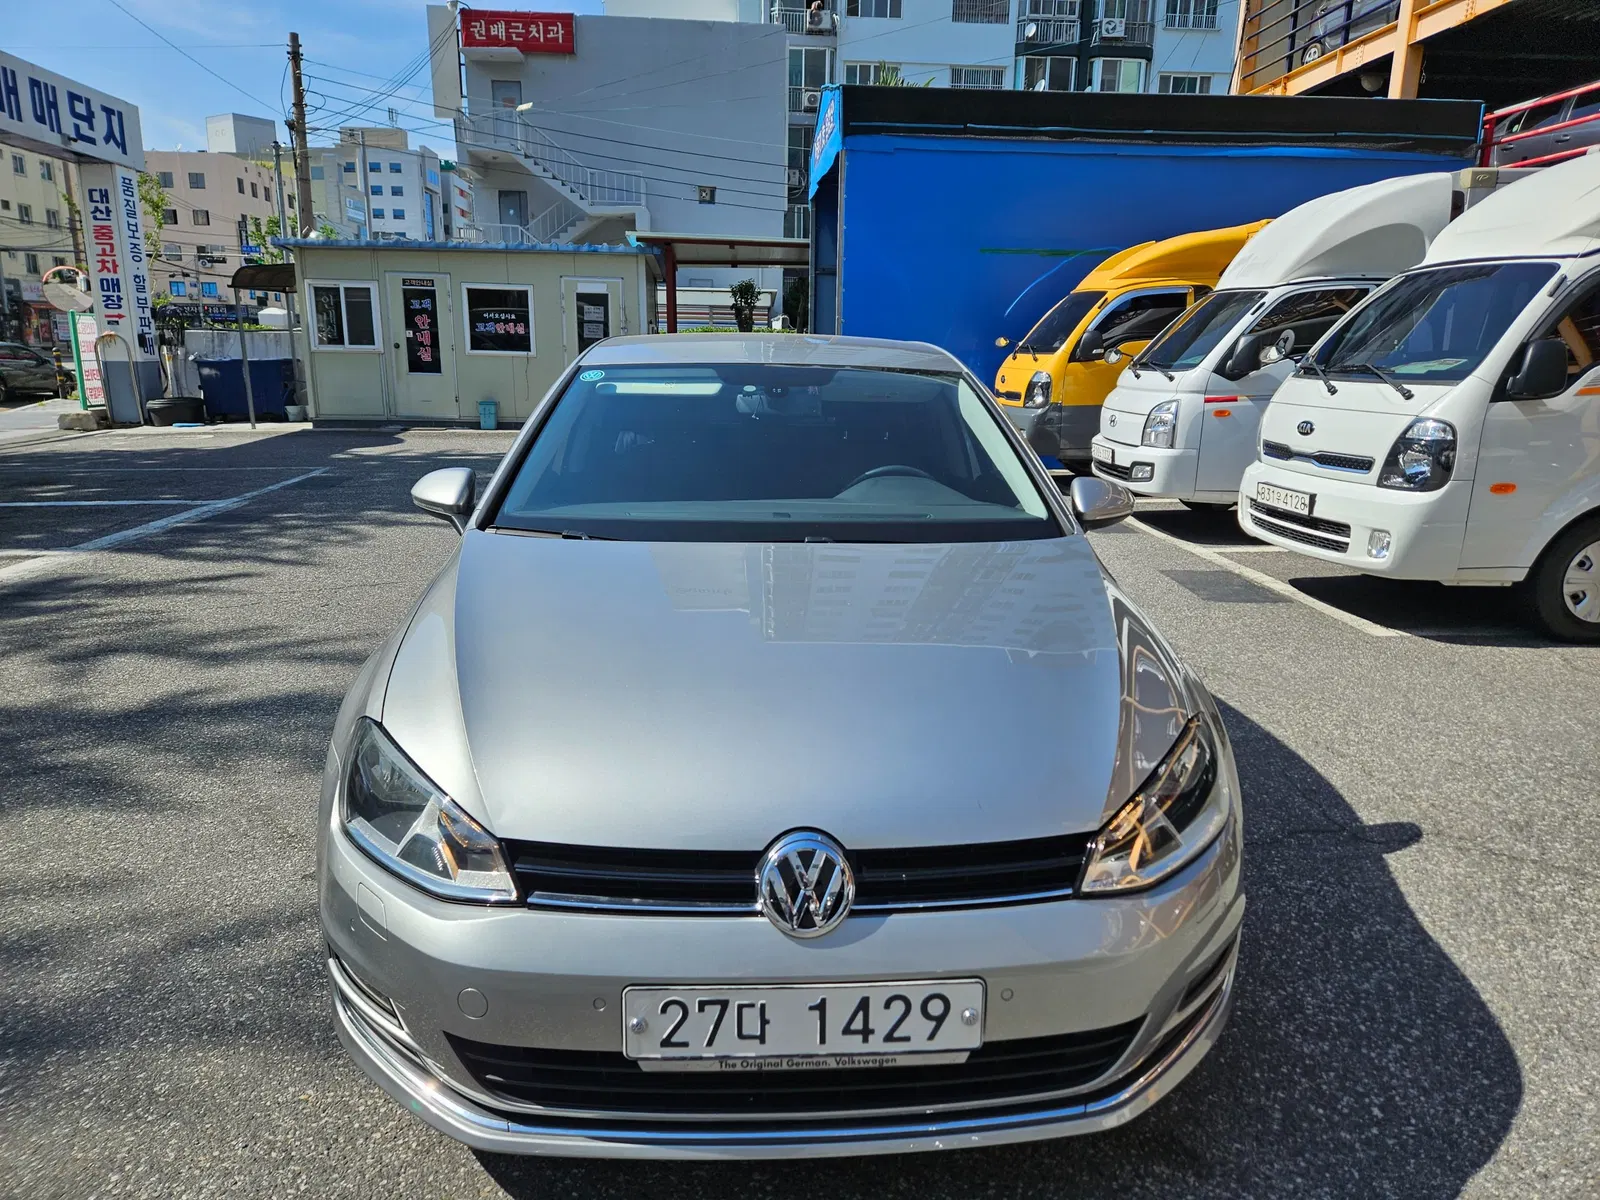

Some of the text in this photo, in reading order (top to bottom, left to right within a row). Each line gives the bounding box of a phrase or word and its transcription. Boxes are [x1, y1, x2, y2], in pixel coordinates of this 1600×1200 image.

[469, 19, 565, 43] 권배근치과
[88, 188, 112, 222] 대산
[121, 176, 142, 263] 품질보증
[92, 224, 120, 274] 중고차
[100, 277, 123, 310] 매장
[410, 299, 431, 310] 고객
[415, 314, 432, 362] 안내실
[1298, 422, 1312, 434] KIA
[1283, 492, 1306, 511] 4128
[658, 992, 952, 1048] 27다 1429
[719, 1060, 737, 1069] The
[741, 1059, 783, 1071] Original
[835, 1057, 897, 1067] Volkswagen
